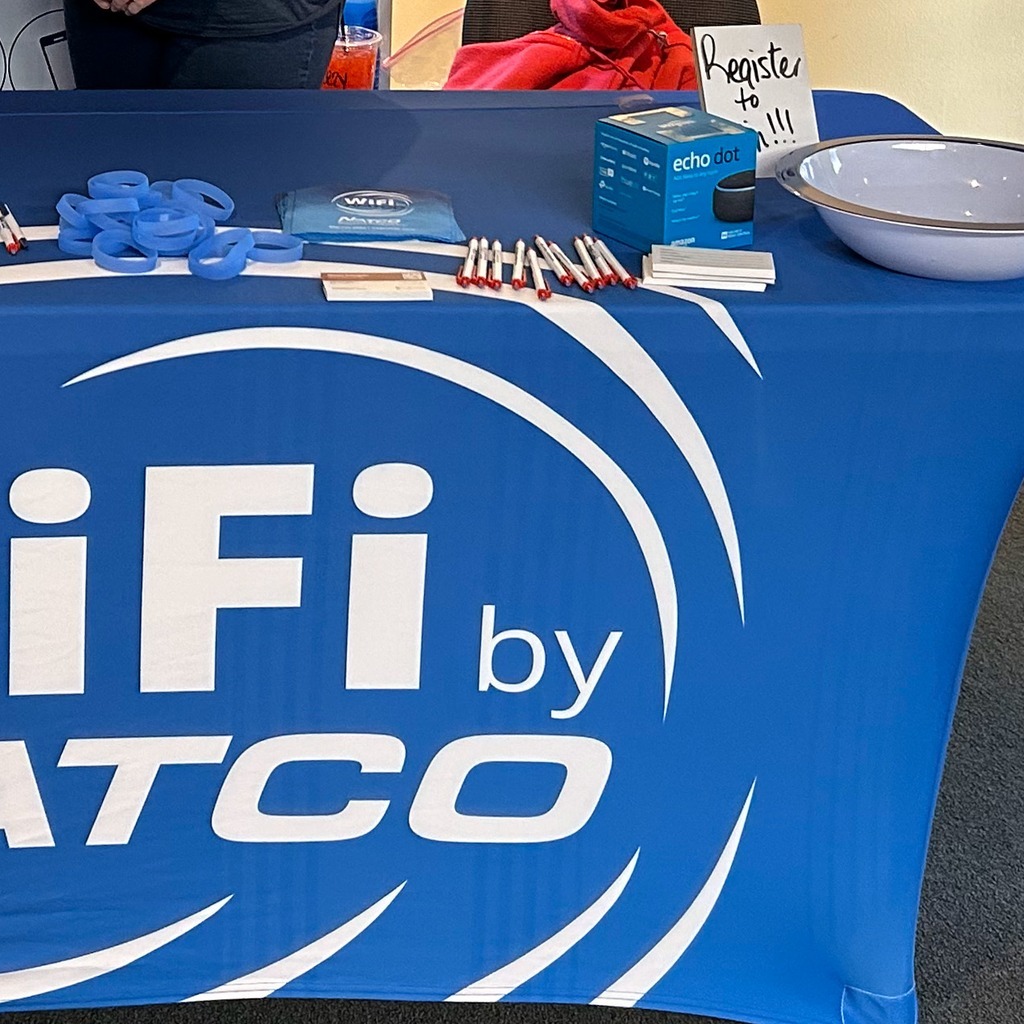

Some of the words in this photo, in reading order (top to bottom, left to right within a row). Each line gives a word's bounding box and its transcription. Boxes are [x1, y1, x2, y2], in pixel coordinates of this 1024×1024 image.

[701, 33, 801, 90] Register
[734, 87, 759, 111] to
[673, 151, 711, 172] echo
[713, 146, 740, 165] dot
[478, 604, 624, 720] by
